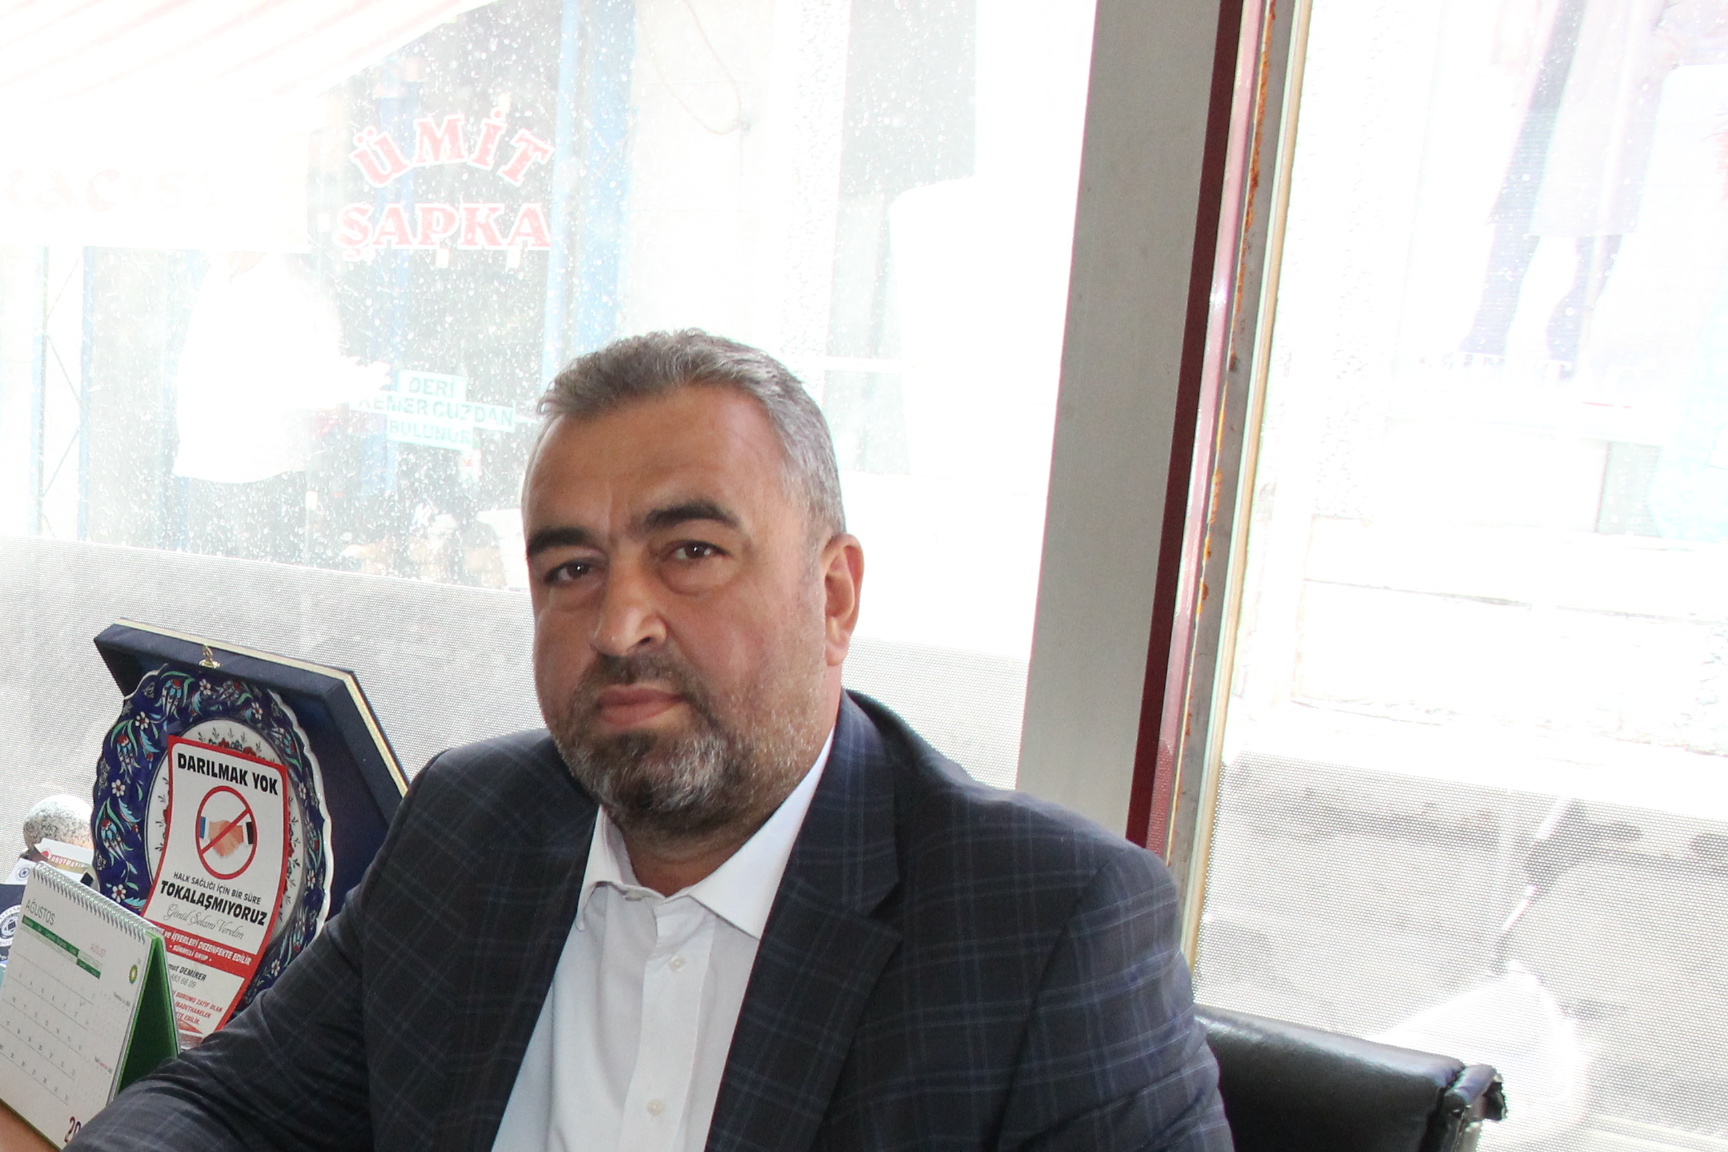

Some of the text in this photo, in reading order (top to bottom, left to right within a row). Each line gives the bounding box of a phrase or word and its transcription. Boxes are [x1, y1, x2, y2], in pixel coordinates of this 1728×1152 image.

[349, 106, 557, 187] ÜMİT
[333, 202, 553, 261] ŞAPKA
[177, 752, 279, 796] DARILMAK YOK
[160, 880, 269, 926] TOKALAŞMIYORUZ
[173, 871, 262, 906] HALK SAĞLIĞI İÇİN BİR SÜRE
[25, 898, 57, 926] AĞUSTOS
